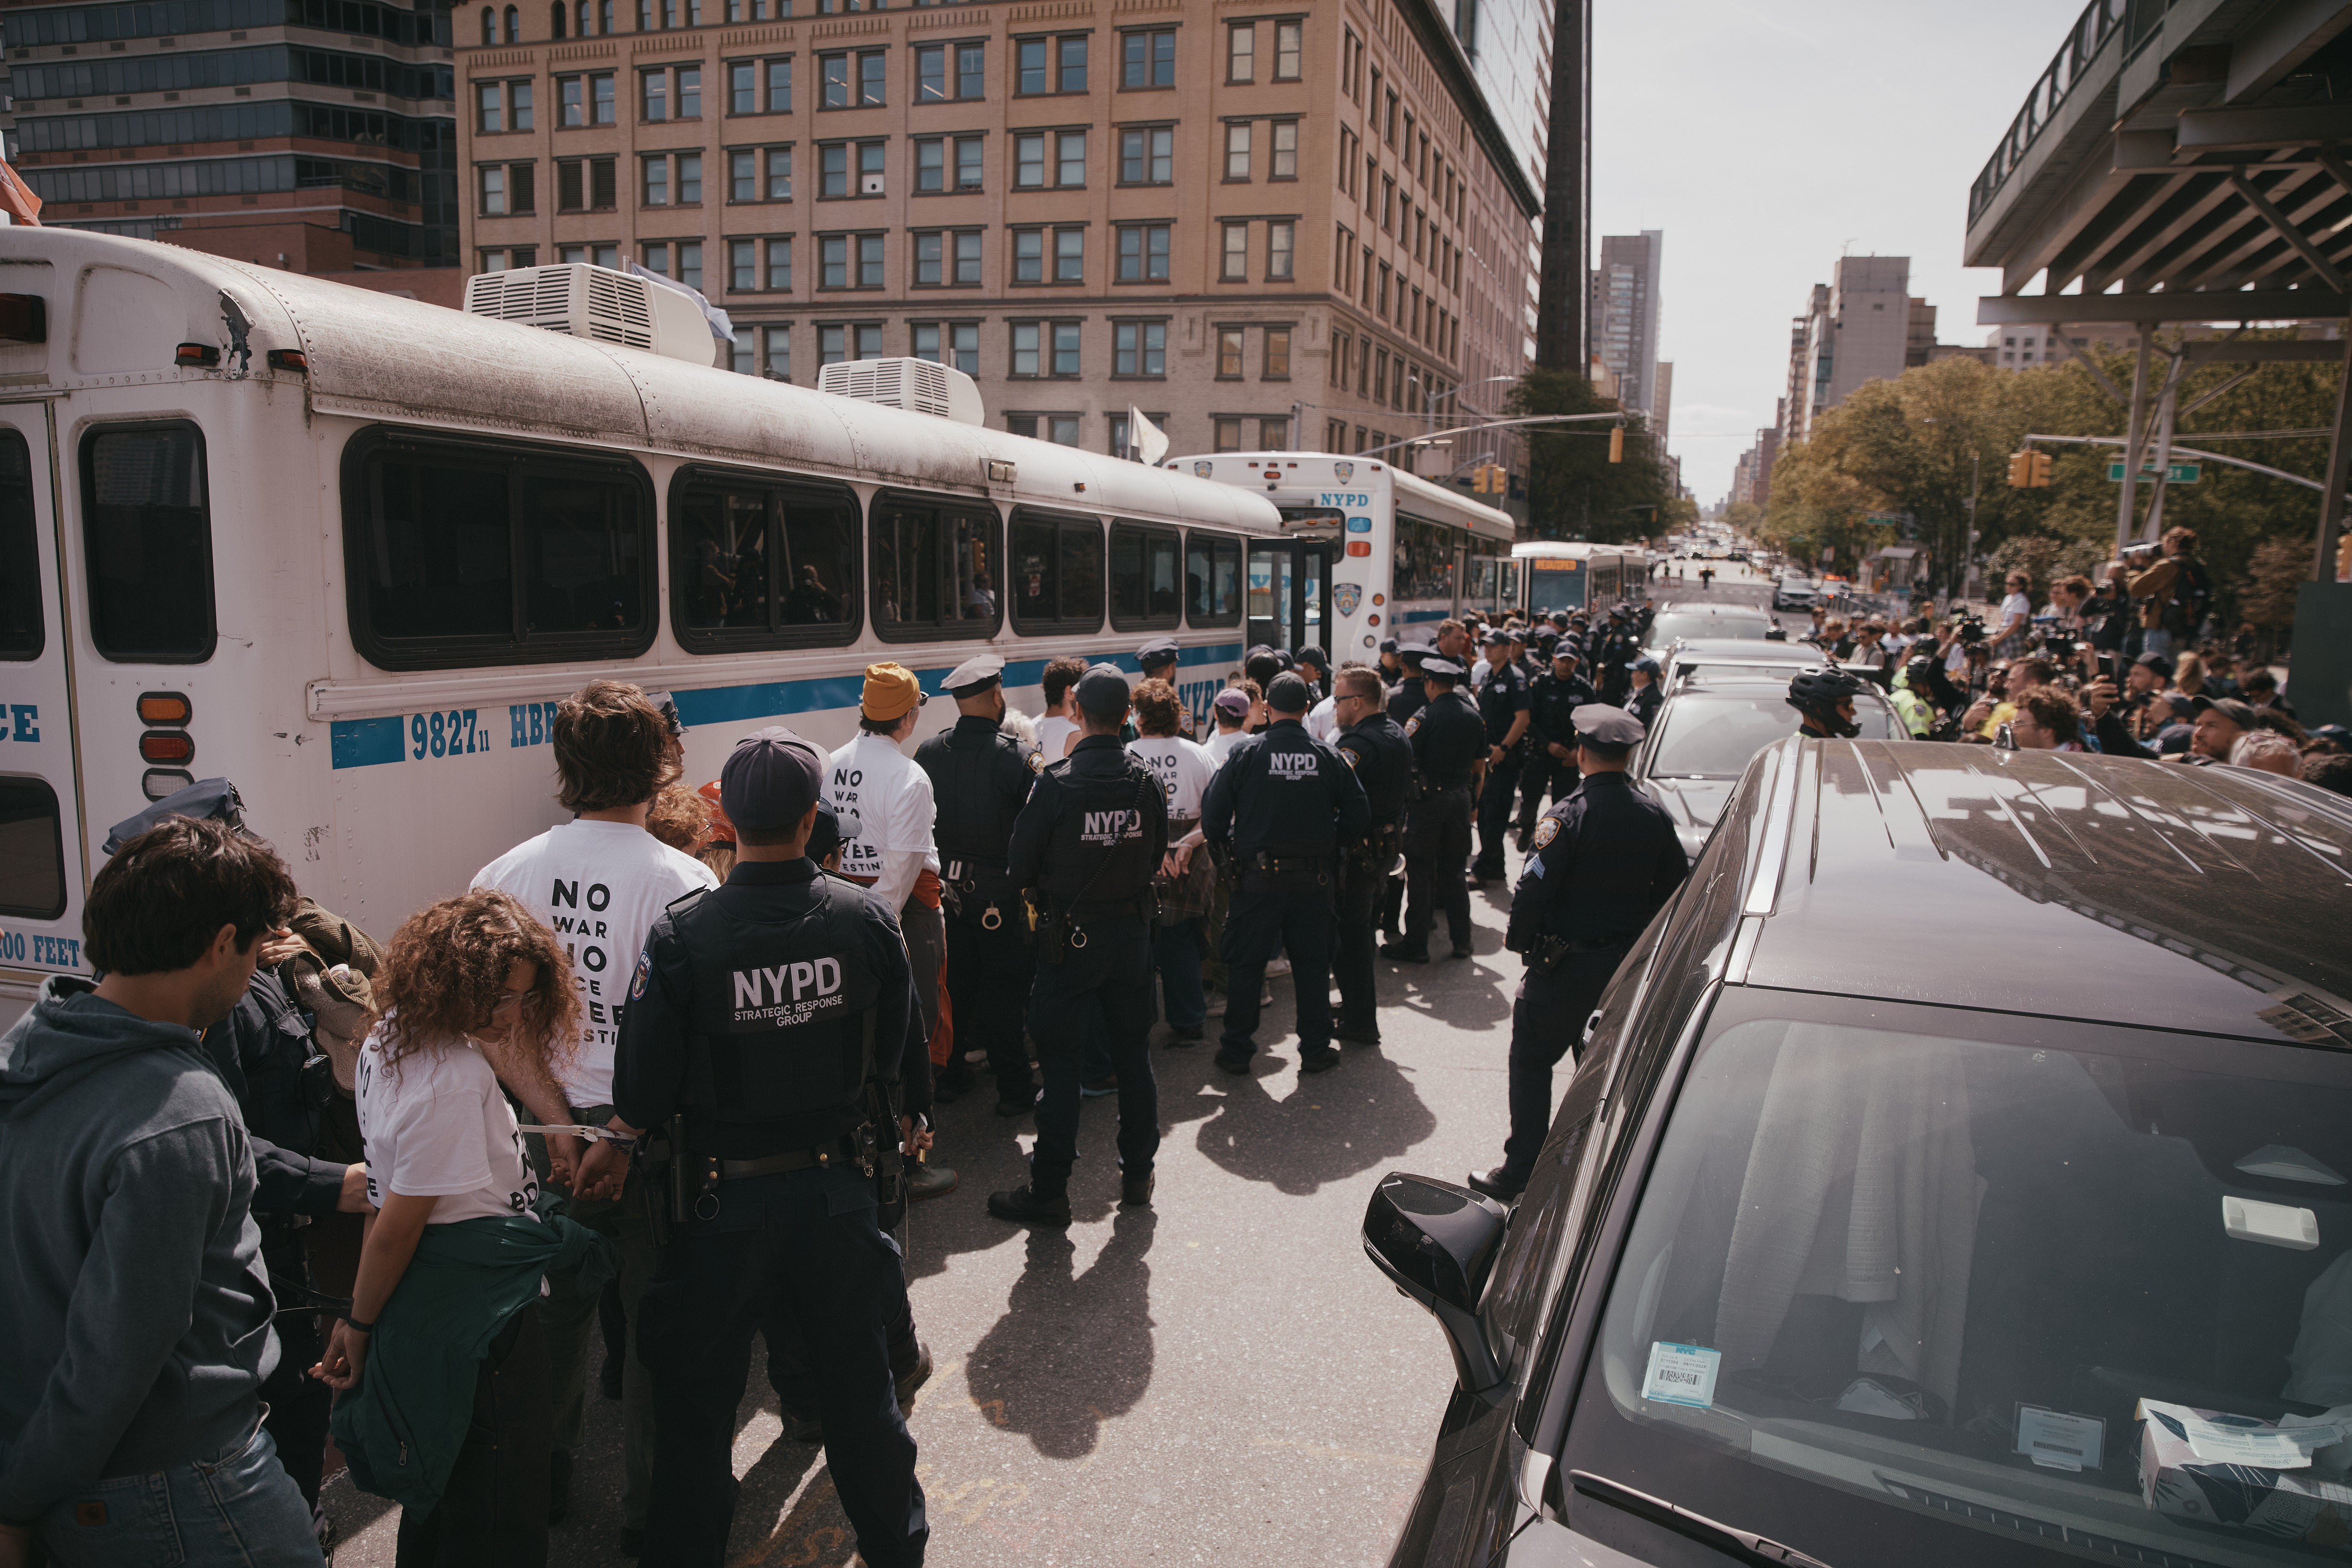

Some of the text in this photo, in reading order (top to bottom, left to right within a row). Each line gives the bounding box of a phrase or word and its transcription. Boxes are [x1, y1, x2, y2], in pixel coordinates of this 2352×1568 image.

[1321, 493, 1368, 506] NYPD
[1151, 755, 1176, 768] NO
[1271, 753, 1317, 770] NYPD
[834, 769, 863, 787] NO
[834, 791, 858, 803] WAR
[1084, 809, 1141, 834] NYPD
[552, 879, 610, 912] NO
[552, 915, 607, 939] WAR
[0, 931, 79, 967] 00 FEET
[733, 957, 841, 1009] NYPD
[735, 995, 843, 1021] STRATEGIC RESPONSE
[777, 1011, 812, 1027] GROUP
[1676, 1346, 1696, 1355] NYC
